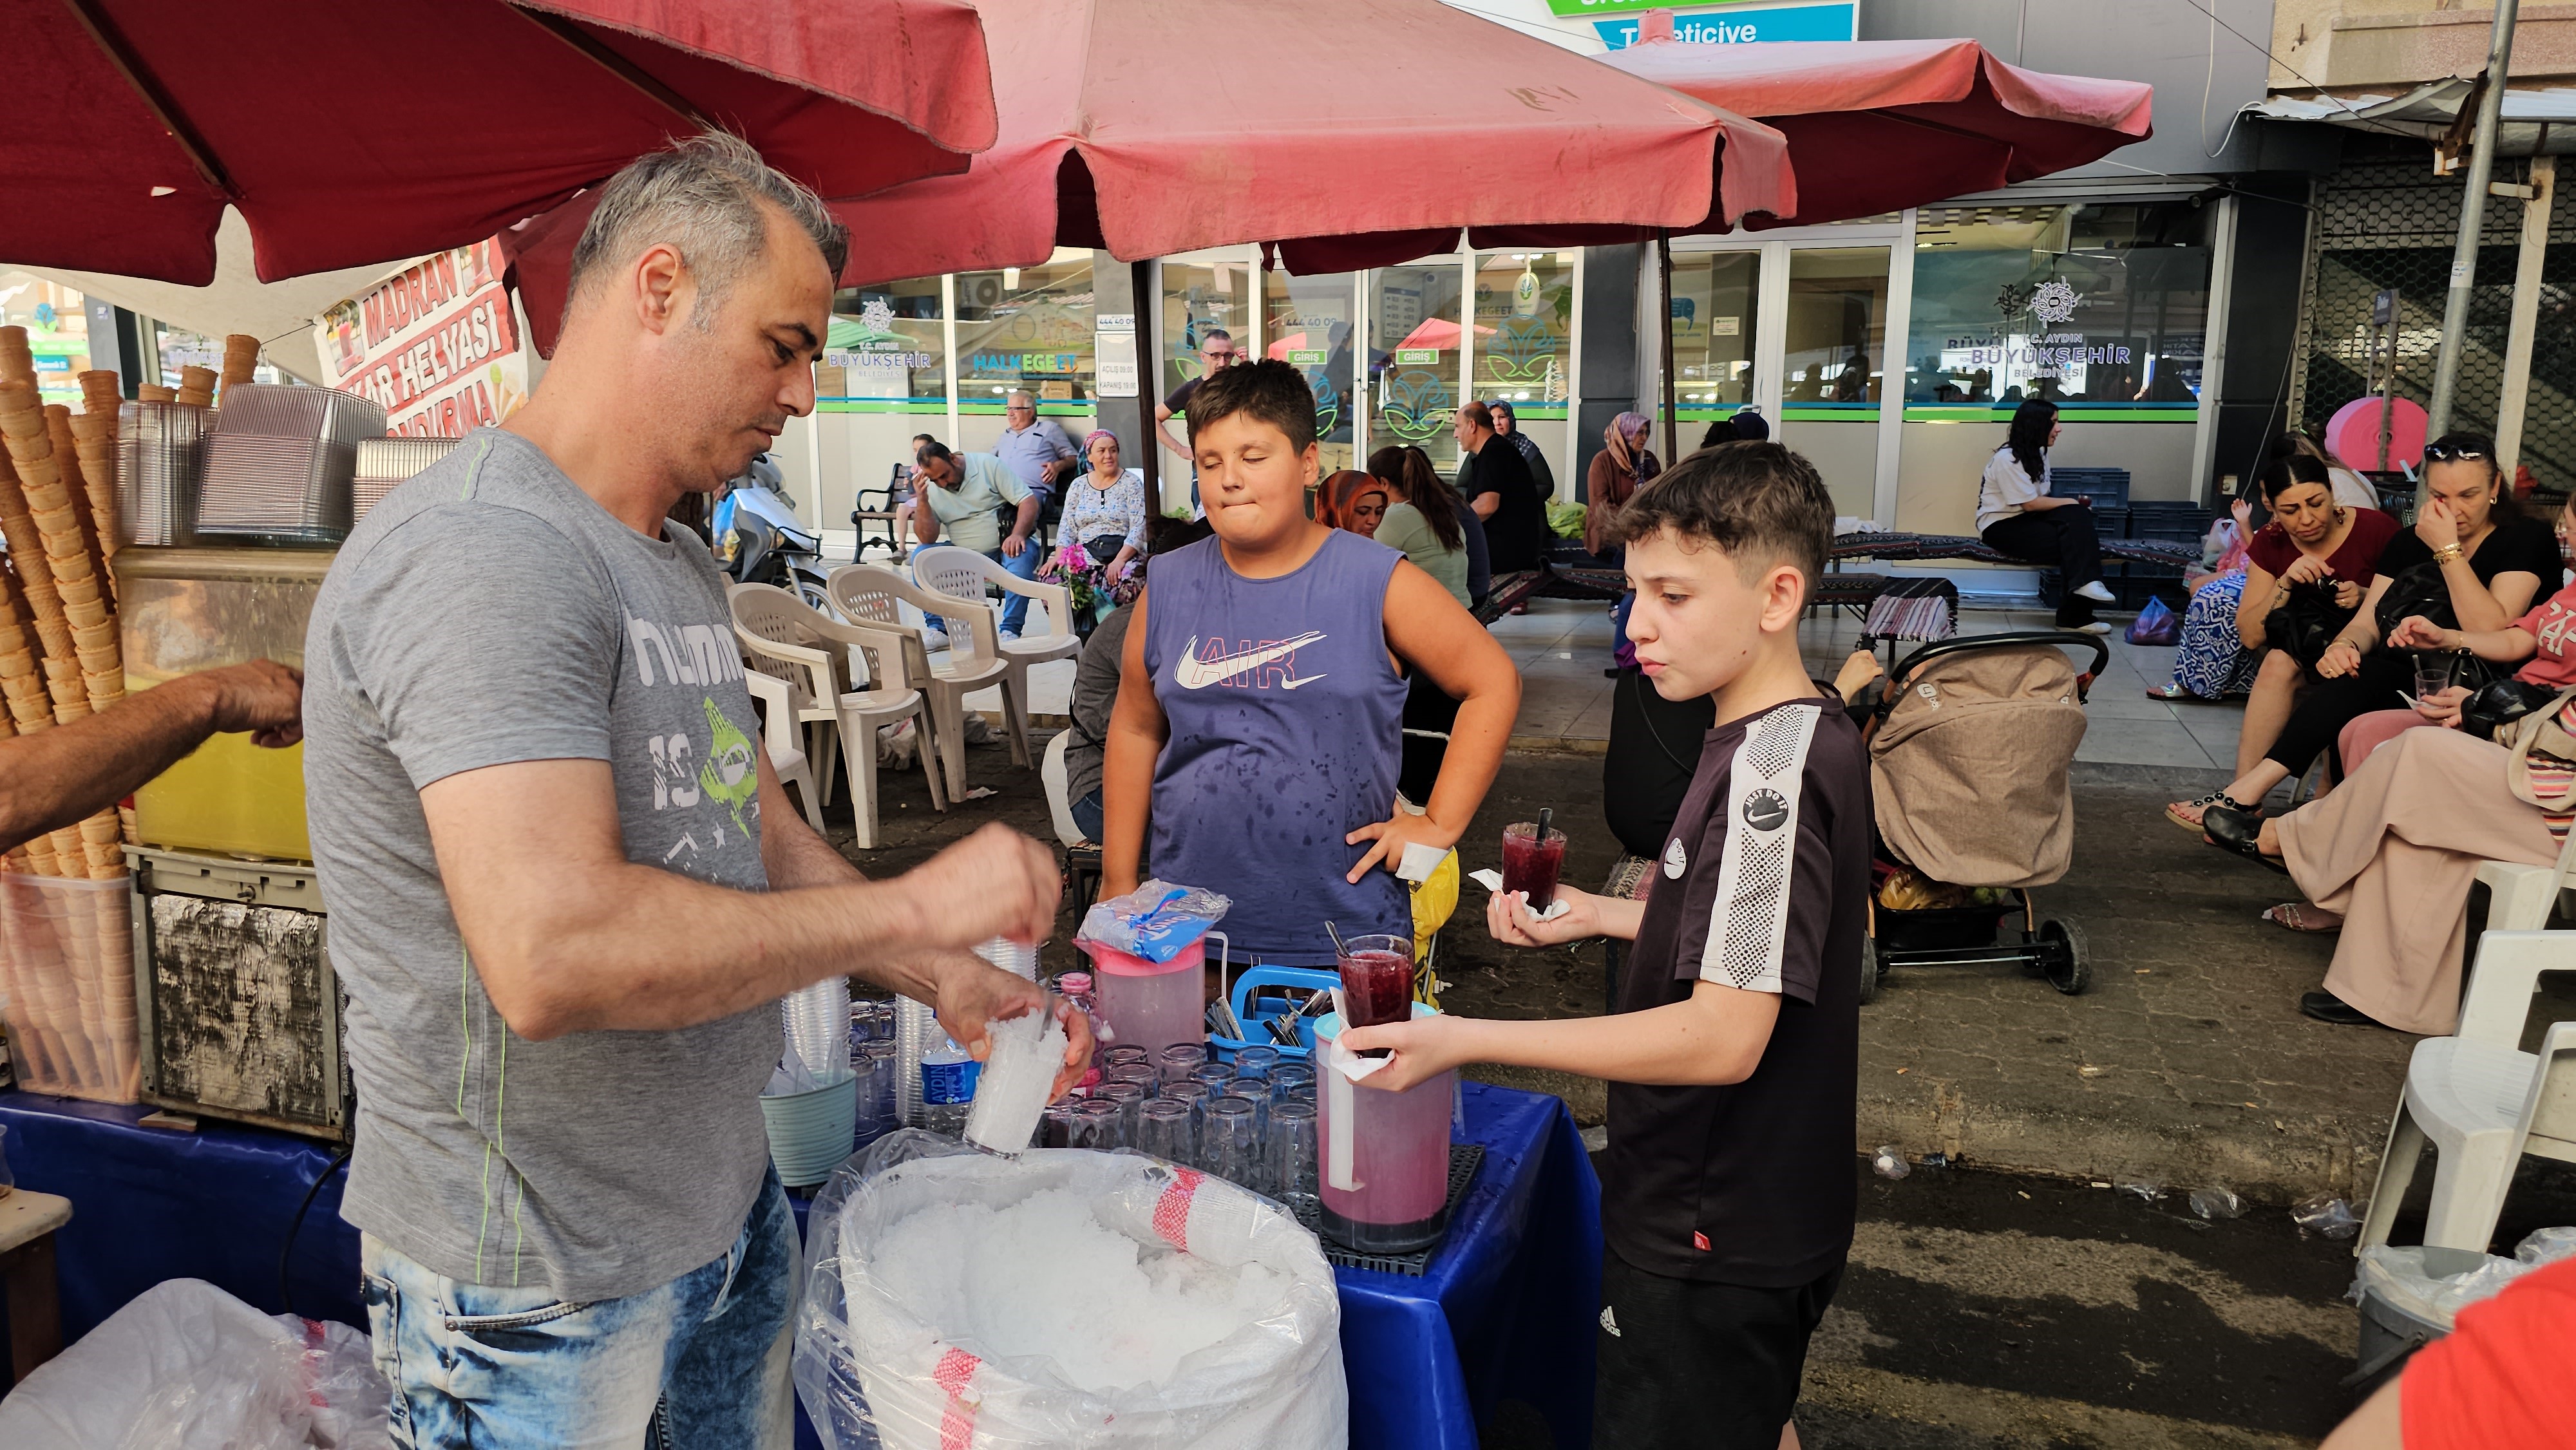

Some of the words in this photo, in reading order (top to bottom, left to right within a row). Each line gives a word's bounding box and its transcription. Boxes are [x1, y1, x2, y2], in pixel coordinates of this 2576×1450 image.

[1620, 21, 1757, 47] Teticiye
[363, 250, 458, 350] MADRAN
[1308, 318, 1320, 326] 40
[2045, 333, 2083, 343] AYDIN
[397, 299, 502, 400] HELVASI
[1294, 352, 1320, 362] GİRİŞ
[1404, 352, 1430, 362] GİRİŞ
[1972, 344, 2130, 369] BÜYÜKŞEHİR
[829, 351, 931, 370] BÜYÜKŞEHİR
[2014, 366, 2083, 378] BELEDİYESİ
[1191, 637, 1296, 689] AIR
[1745, 789, 1763, 807] JUST
[1765, 789, 1780, 800] DO
[1777, 800, 1788, 809] IT
[930, 1066, 946, 1103] AYDIN
